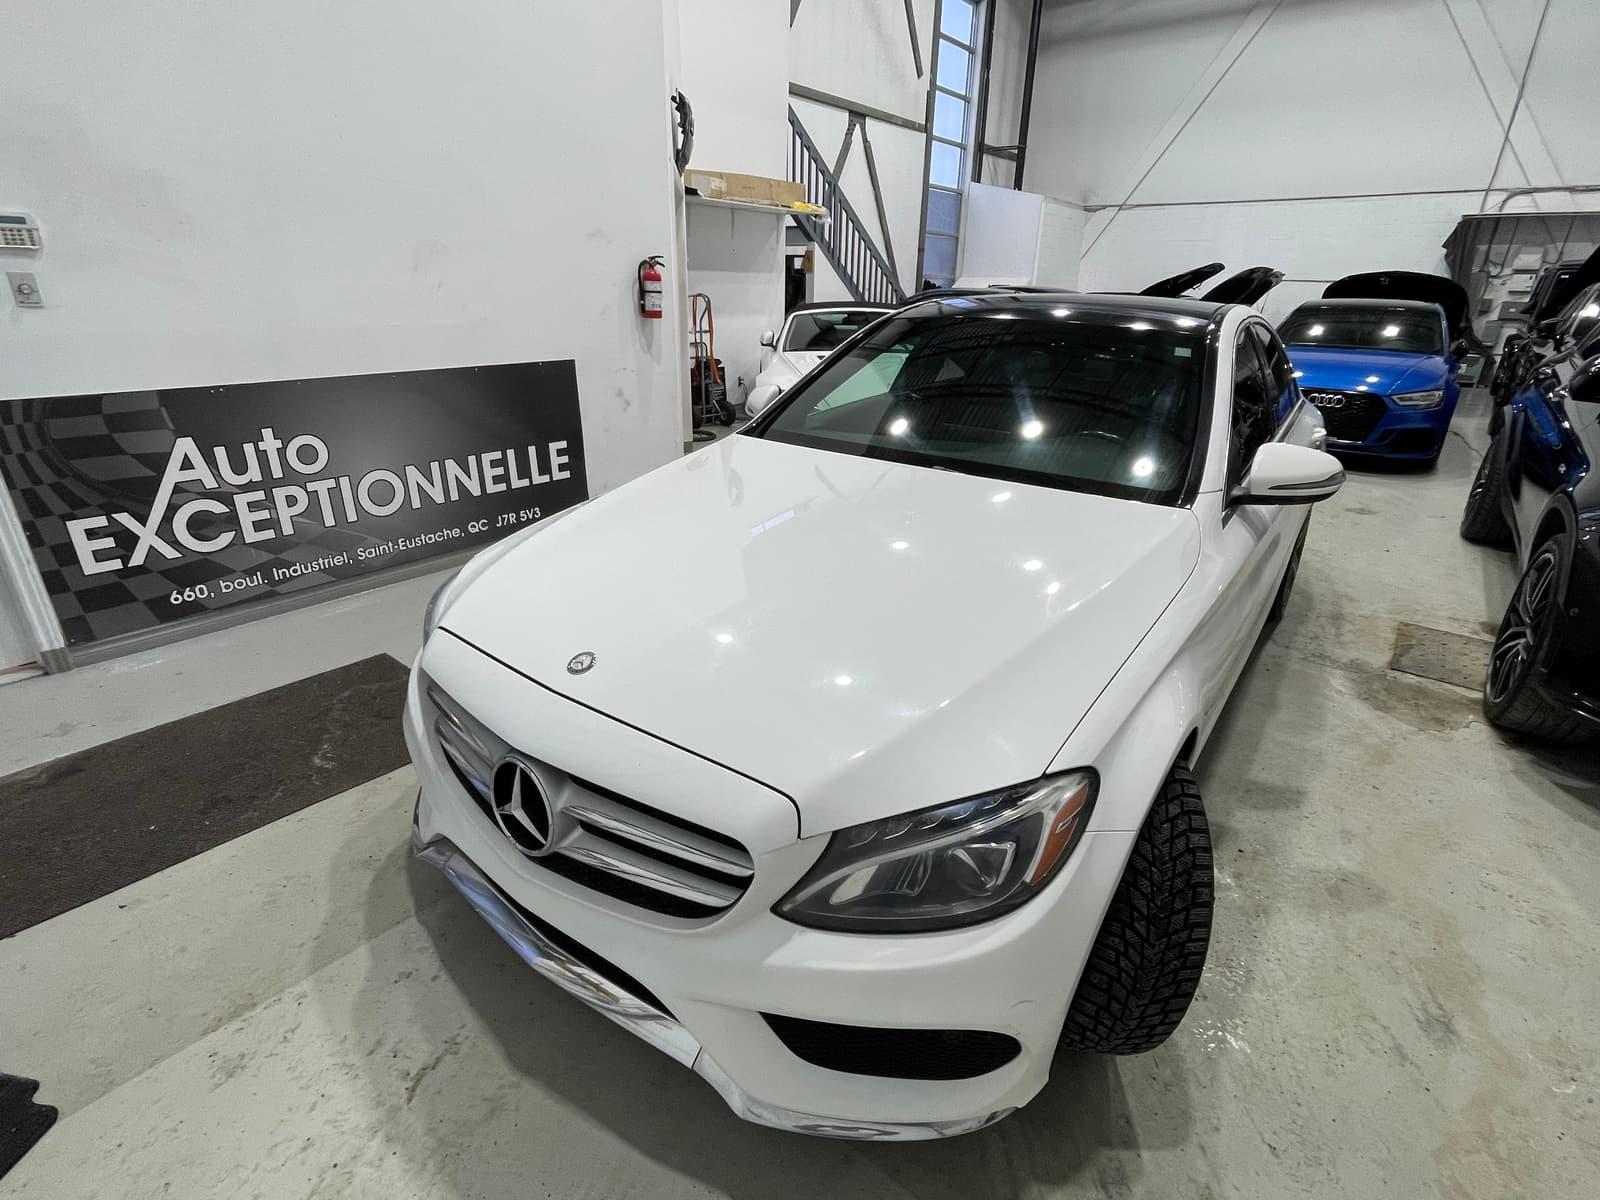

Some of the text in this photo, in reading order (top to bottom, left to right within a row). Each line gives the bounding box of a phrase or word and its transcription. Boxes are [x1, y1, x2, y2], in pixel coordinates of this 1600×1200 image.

[66, 440, 572, 576] EXCEPTIONNELLE
[163, 427, 330, 492] Auto
[169, 507, 541, 605] 660, boul. Industriel, Saint-Eustache, QC J7R 5V3
